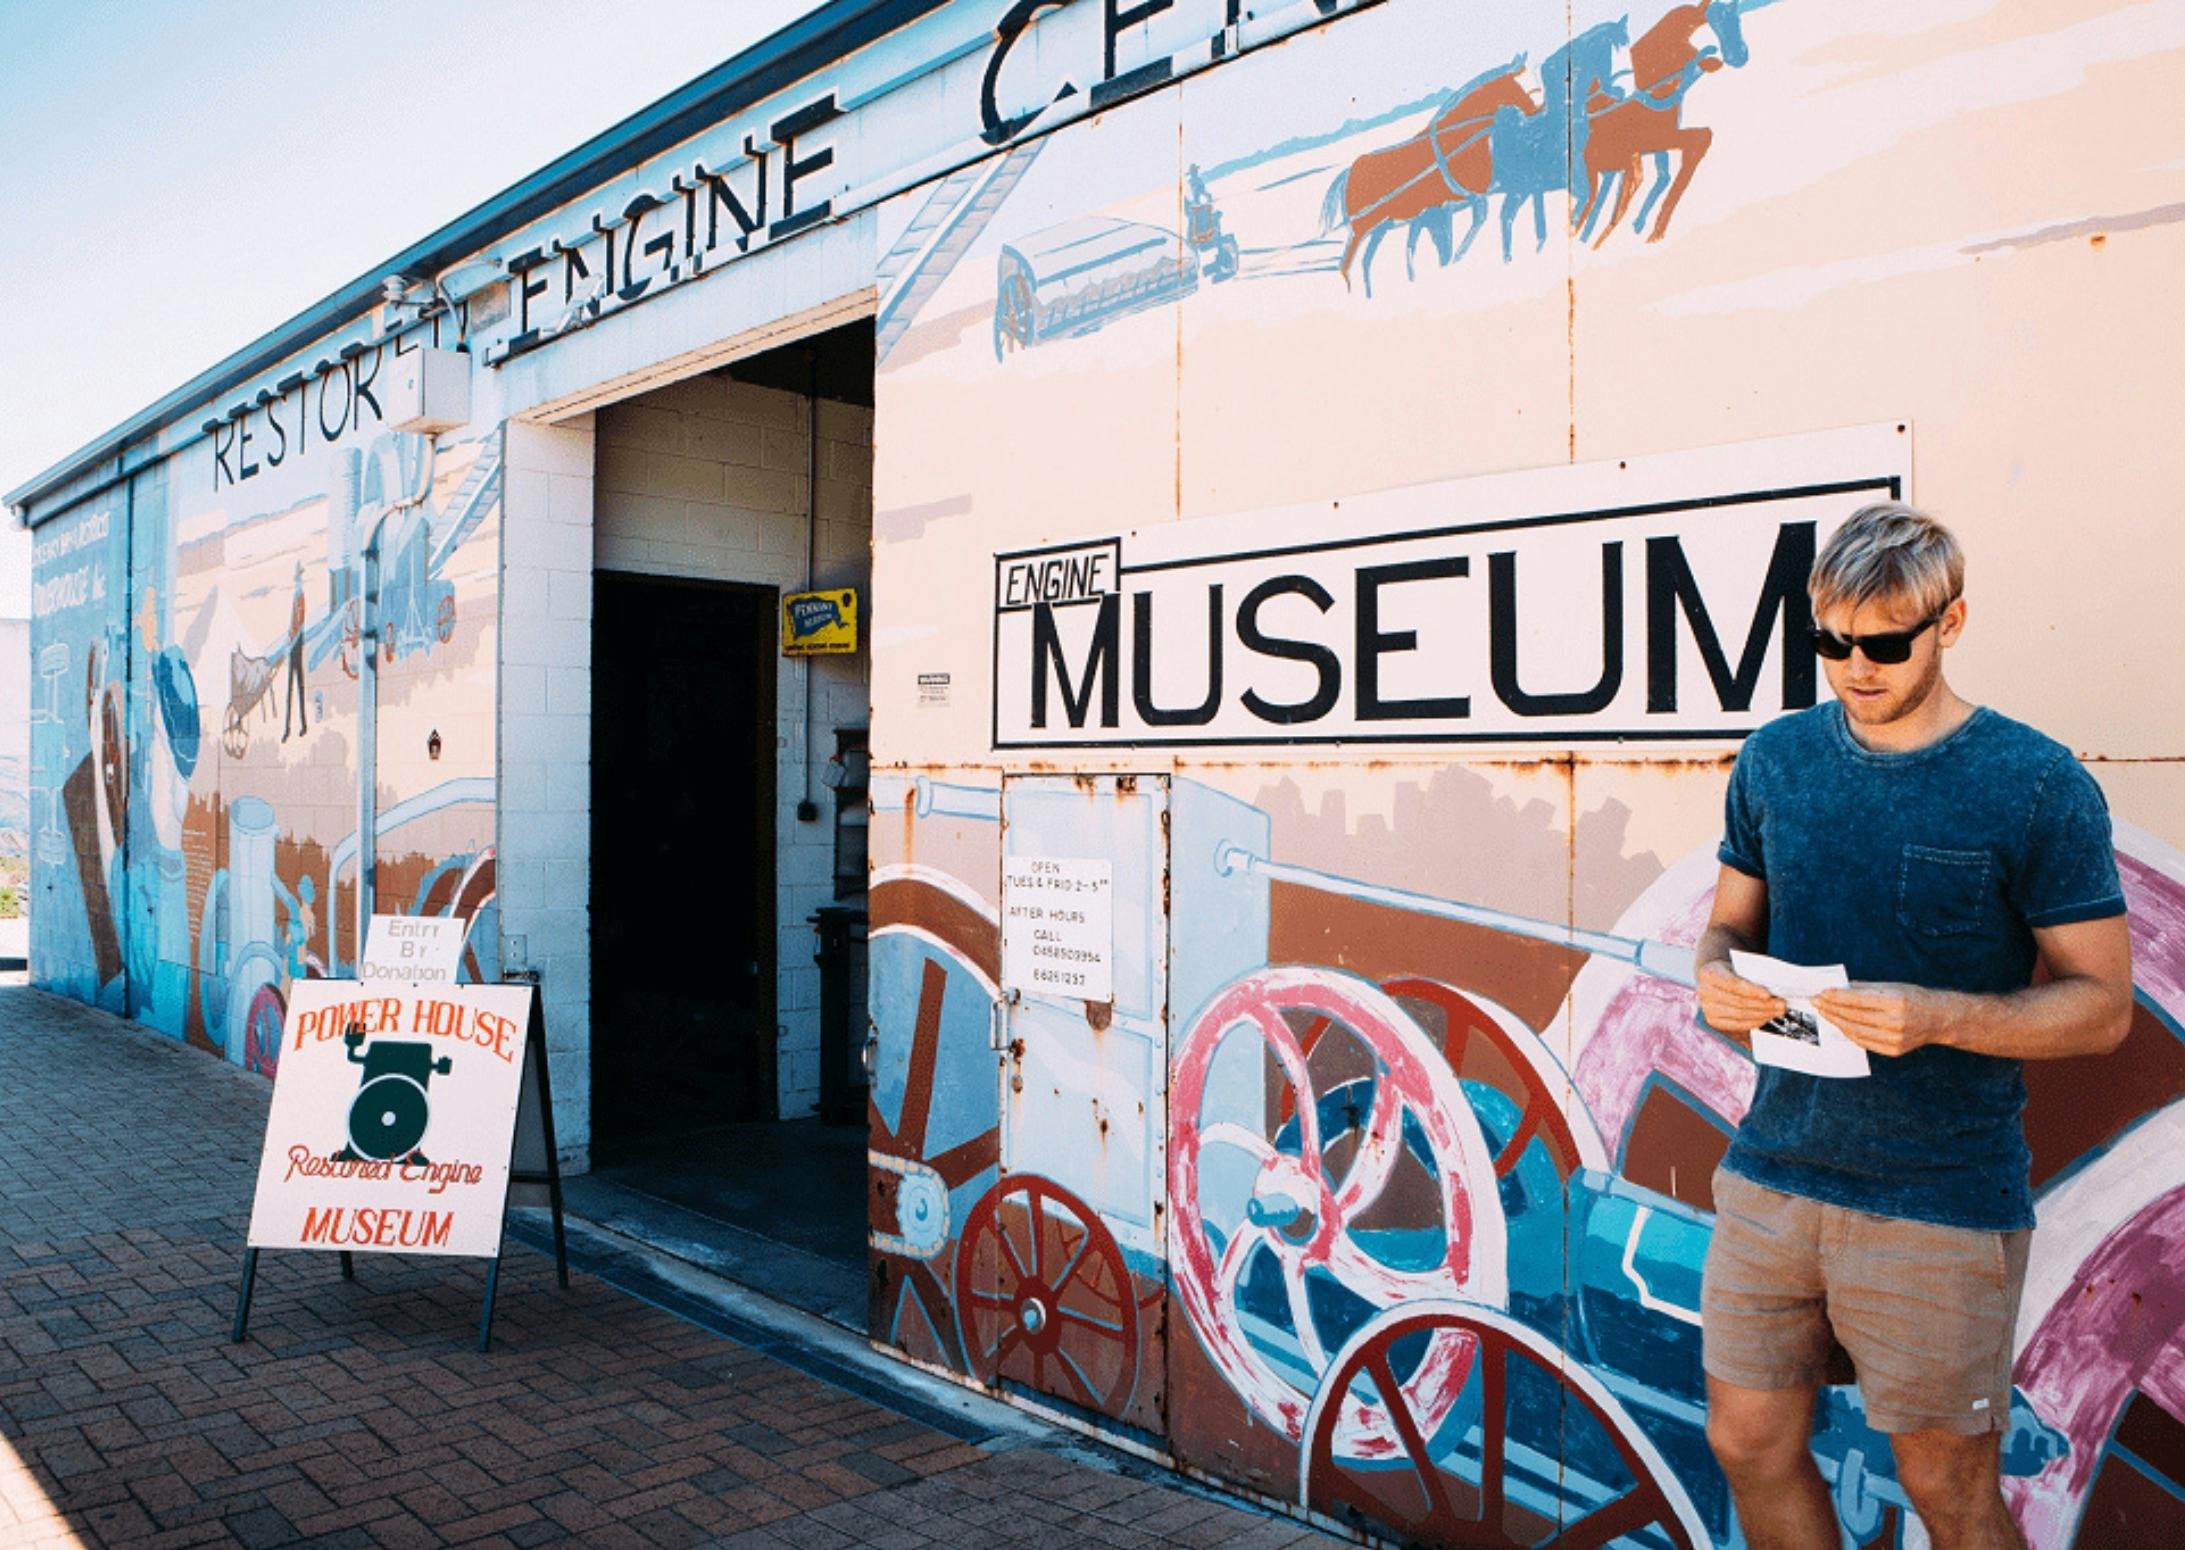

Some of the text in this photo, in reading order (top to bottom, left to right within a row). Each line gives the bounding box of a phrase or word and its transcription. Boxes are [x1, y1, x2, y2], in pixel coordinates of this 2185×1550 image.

[508, 92, 841, 354] ENGINE
[1006, 552, 1108, 606] ENGINE
[1031, 520, 1818, 729] MUSEUM
[1007, 875, 1033, 889] TUES
[1031, 861, 1060, 874] OPEN
[1009, 906, 1085, 924] AFTER HOURS
[1033, 928, 1062, 942] CALL
[294, 997, 518, 1064] POWER HOUSE
[284, 1144, 483, 1194] Restored Engine
[300, 1206, 454, 1248] MUSEUM
